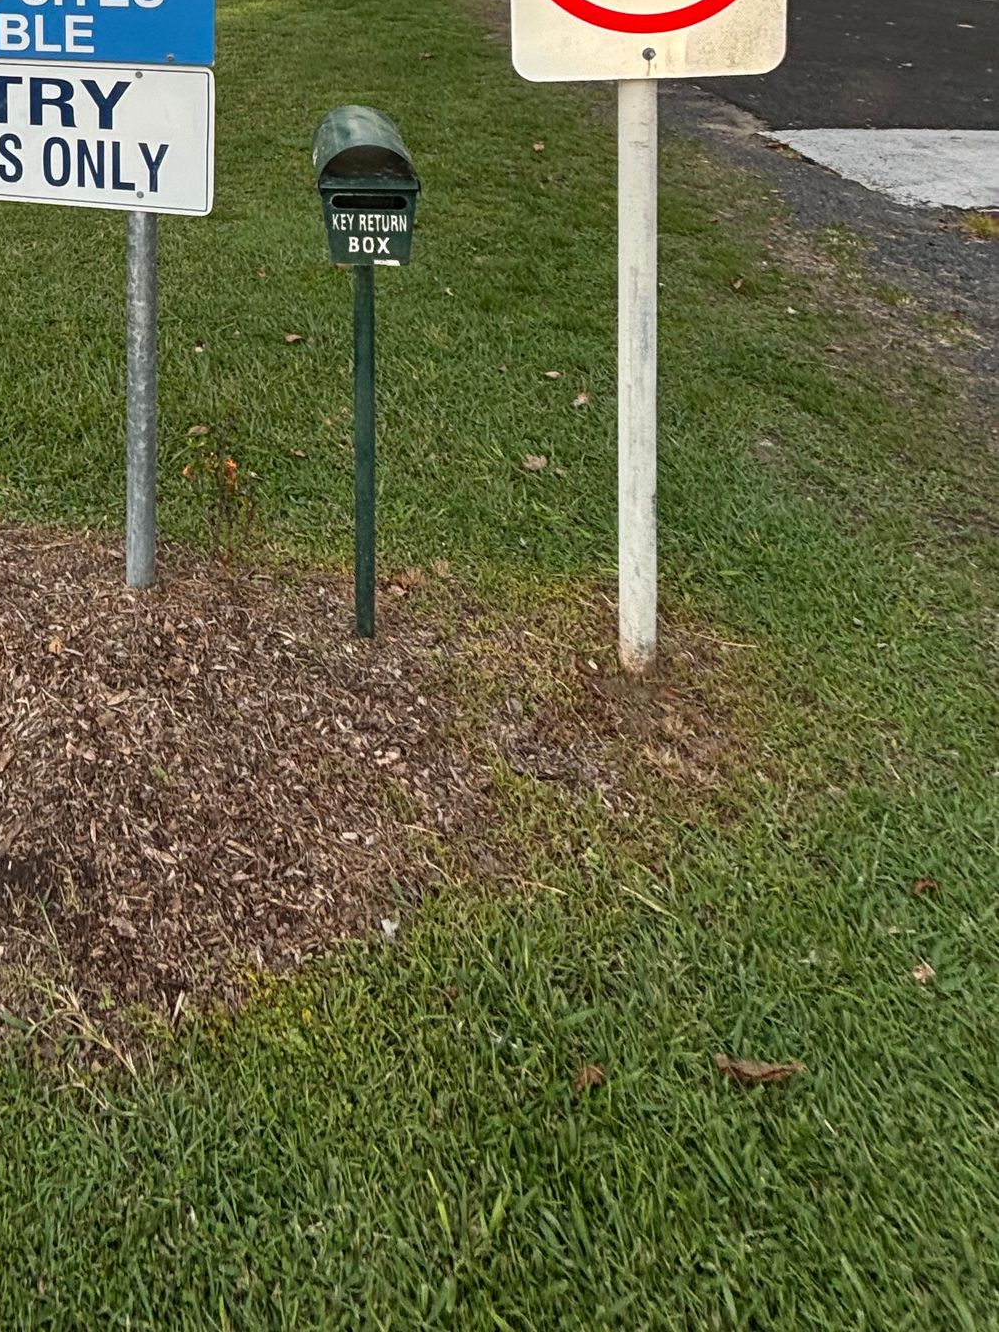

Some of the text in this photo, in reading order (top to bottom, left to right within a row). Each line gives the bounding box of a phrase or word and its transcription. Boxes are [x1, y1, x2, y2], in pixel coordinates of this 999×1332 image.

[42, 135, 169, 193] ONLY
[332, 213, 408, 233] KEY RETURN
[348, 236, 391, 255] BOX
